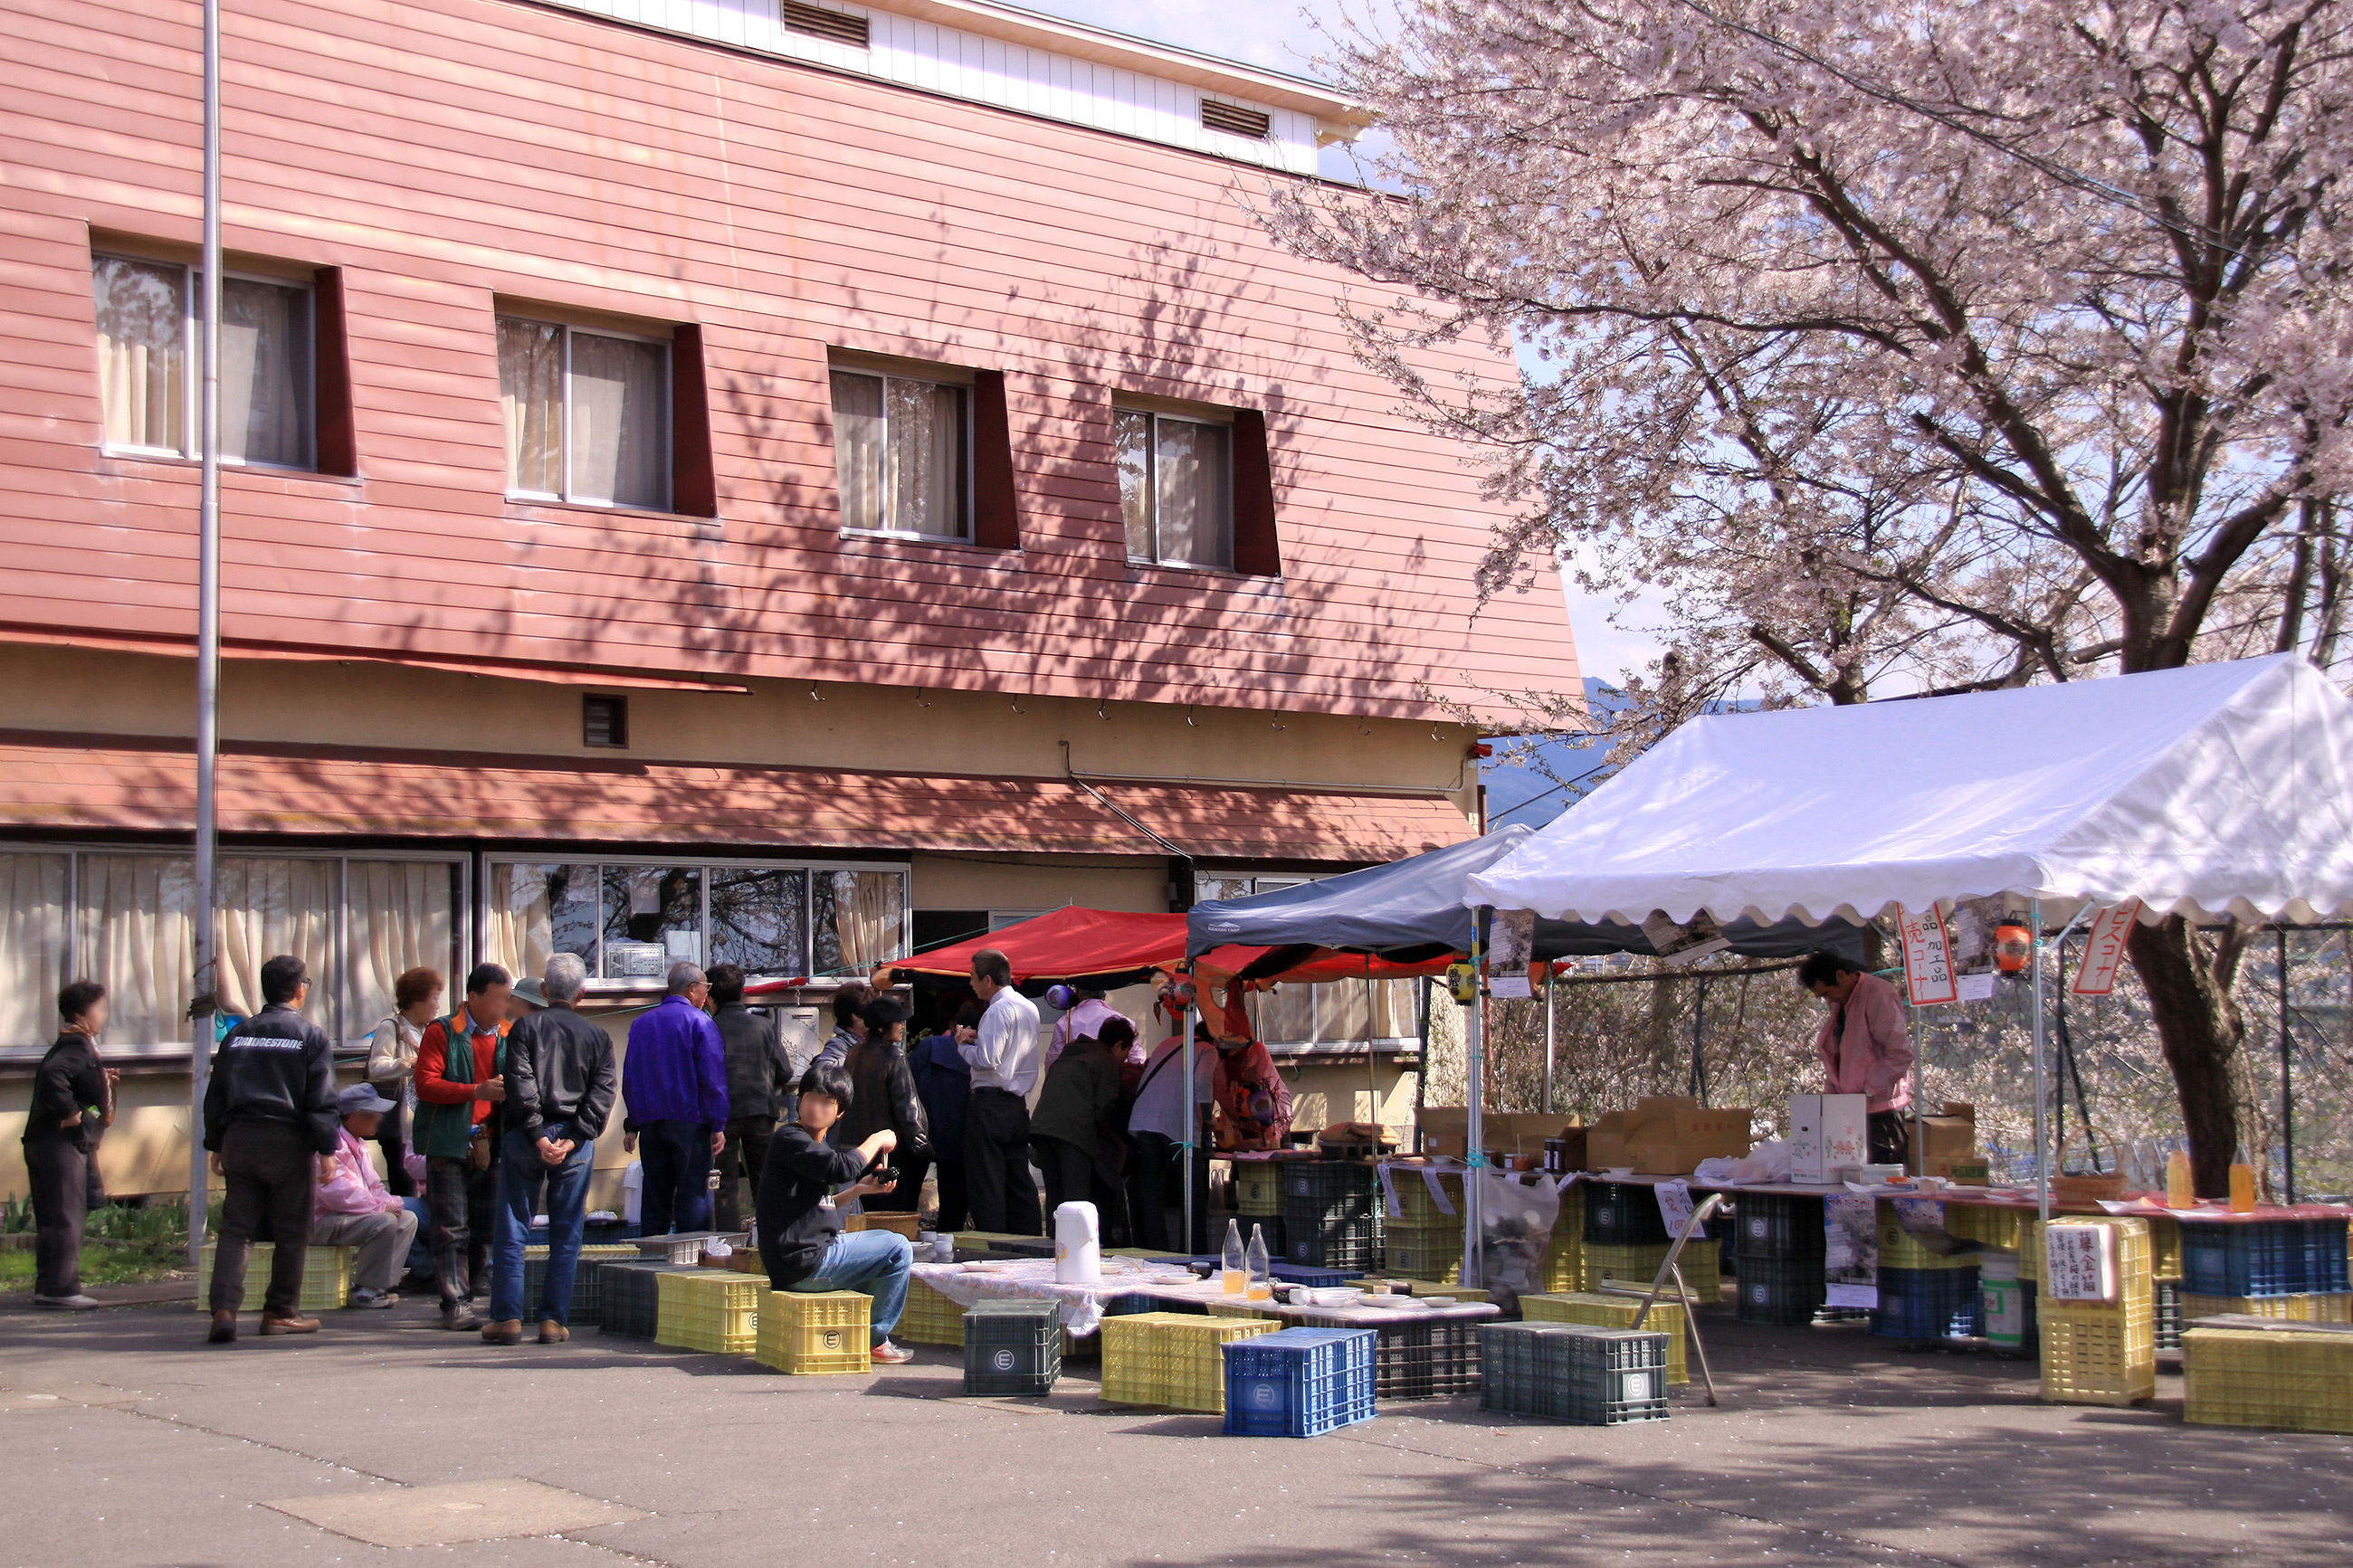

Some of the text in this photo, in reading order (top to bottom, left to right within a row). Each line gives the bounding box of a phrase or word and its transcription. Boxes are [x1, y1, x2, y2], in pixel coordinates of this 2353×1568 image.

[1900, 905, 1929, 1001] 売コーナー
[231, 1036, 304, 1050] BRIDGESTONE
[2077, 1231, 2096, 1292] 募金箱
